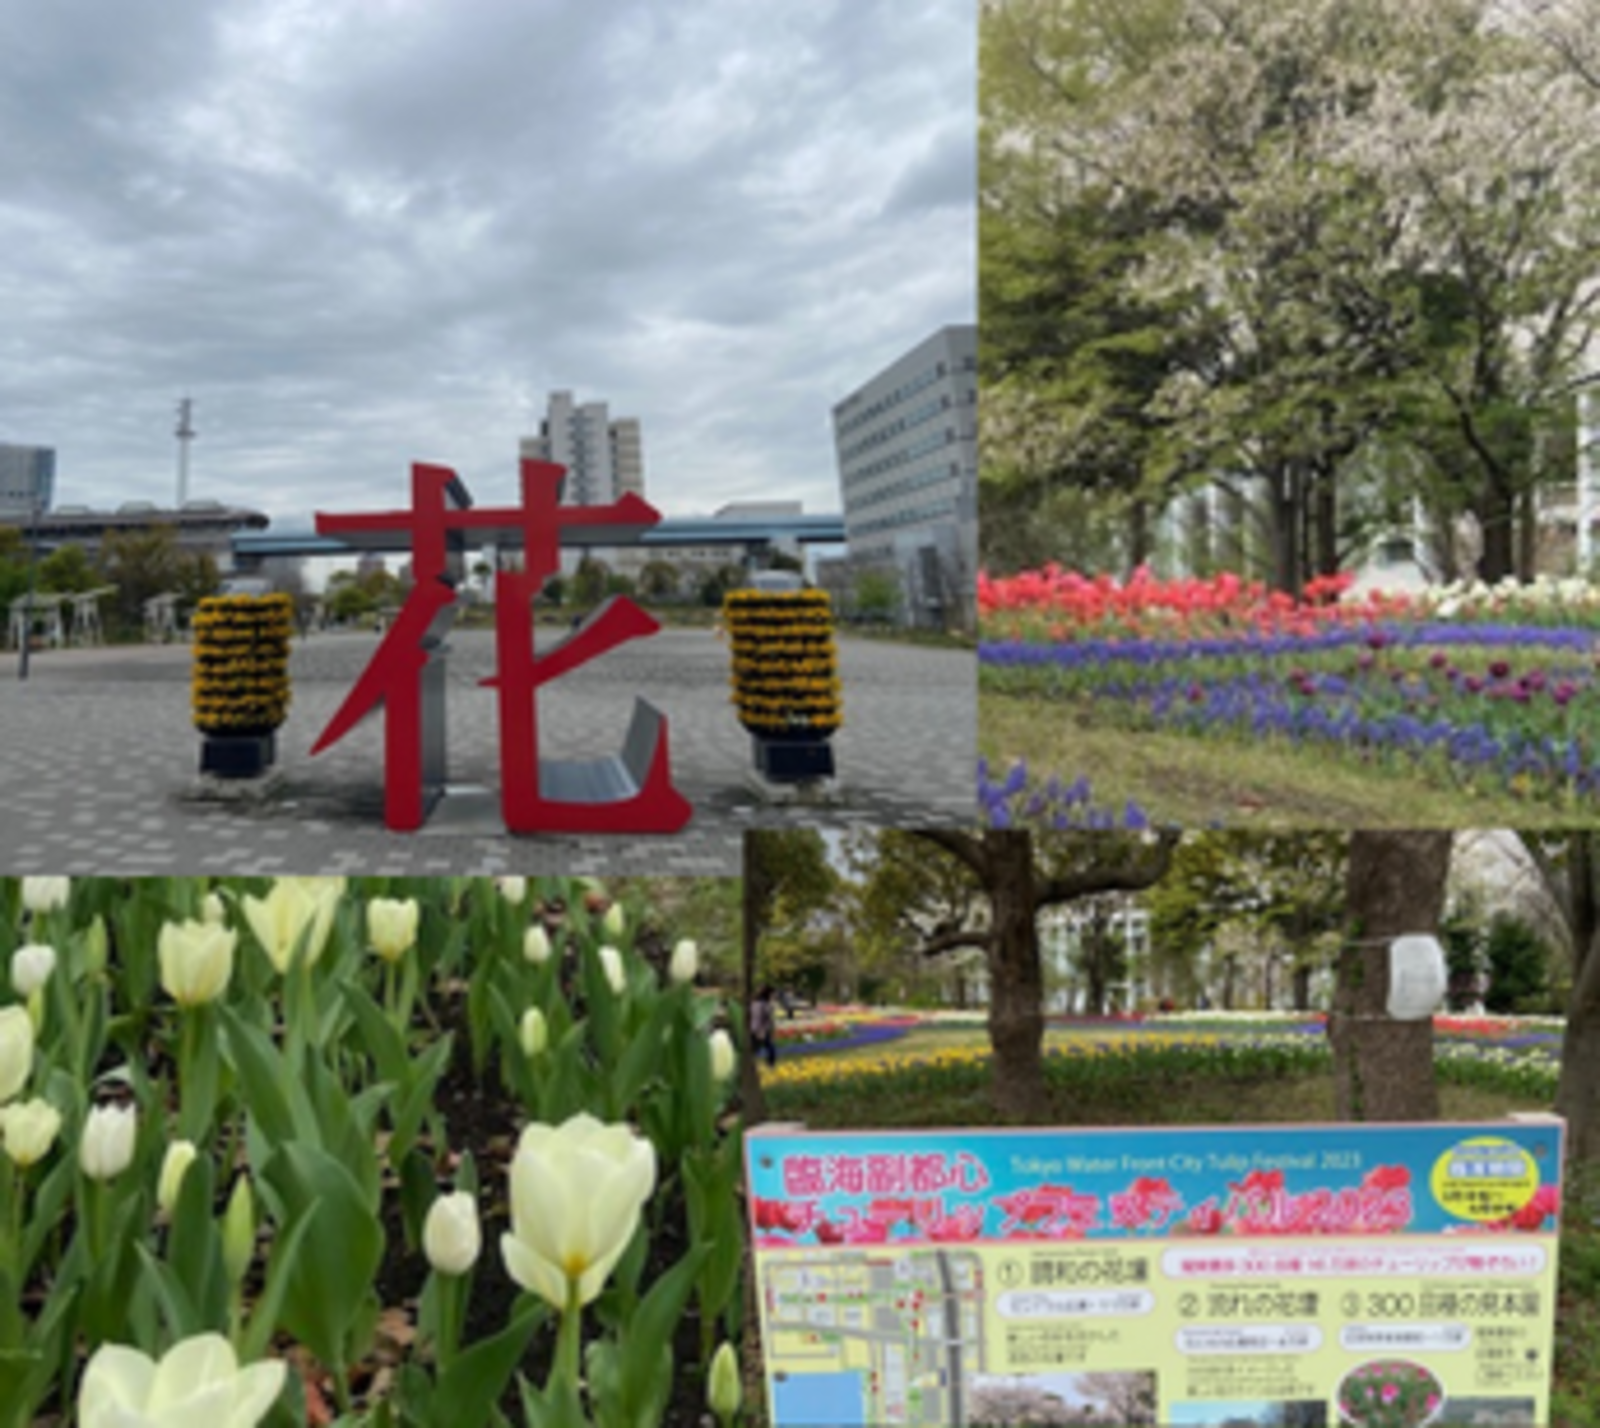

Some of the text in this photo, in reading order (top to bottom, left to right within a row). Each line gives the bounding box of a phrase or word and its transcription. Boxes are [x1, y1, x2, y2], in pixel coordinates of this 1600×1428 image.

[309, 457, 692, 833] 花
[1010, 1154, 1062, 1177] Tokyo
[1066, 1155, 1117, 1174] Water
[1121, 1154, 1165, 1172] Front
[1168, 1153, 1202, 1174] City
[1206, 1152, 1248, 1173] Tulip
[1252, 1150, 1316, 1170] Festival
